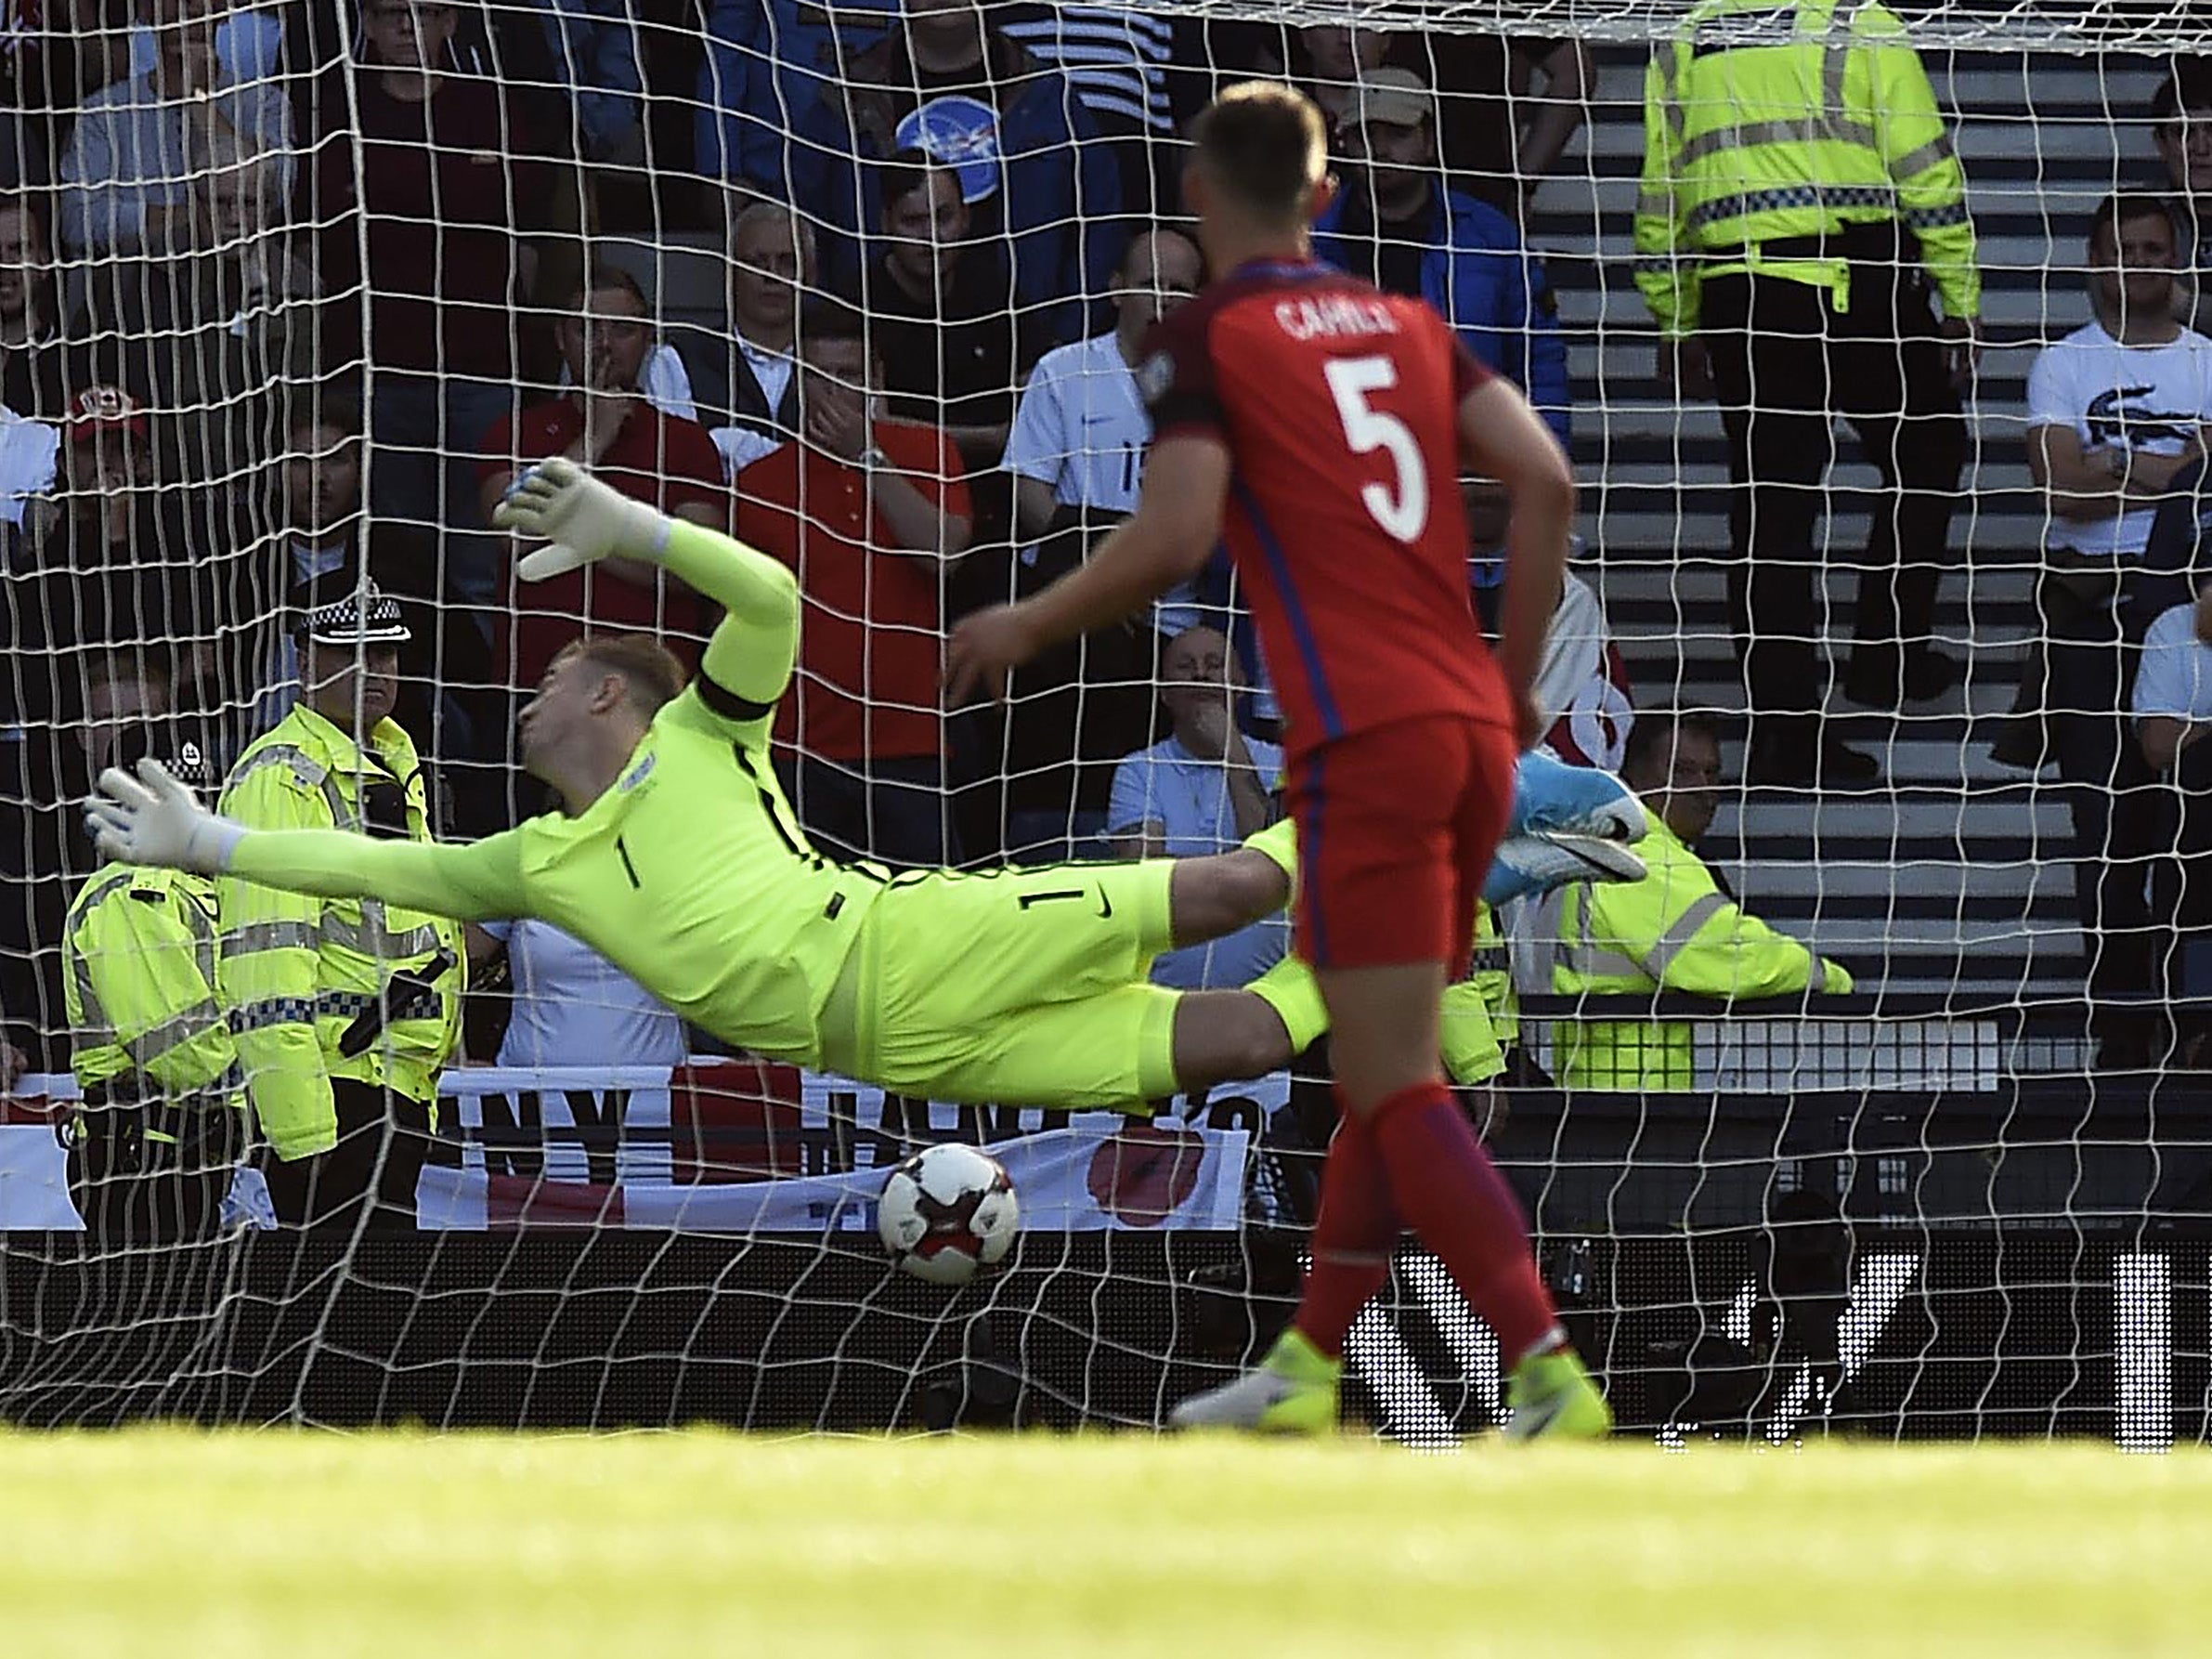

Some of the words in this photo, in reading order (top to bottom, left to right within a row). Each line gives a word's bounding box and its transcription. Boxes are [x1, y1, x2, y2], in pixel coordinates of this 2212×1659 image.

[1323, 356, 1429, 544] 5
[613, 833, 642, 890] 1
[1017, 888, 1086, 912] 1
